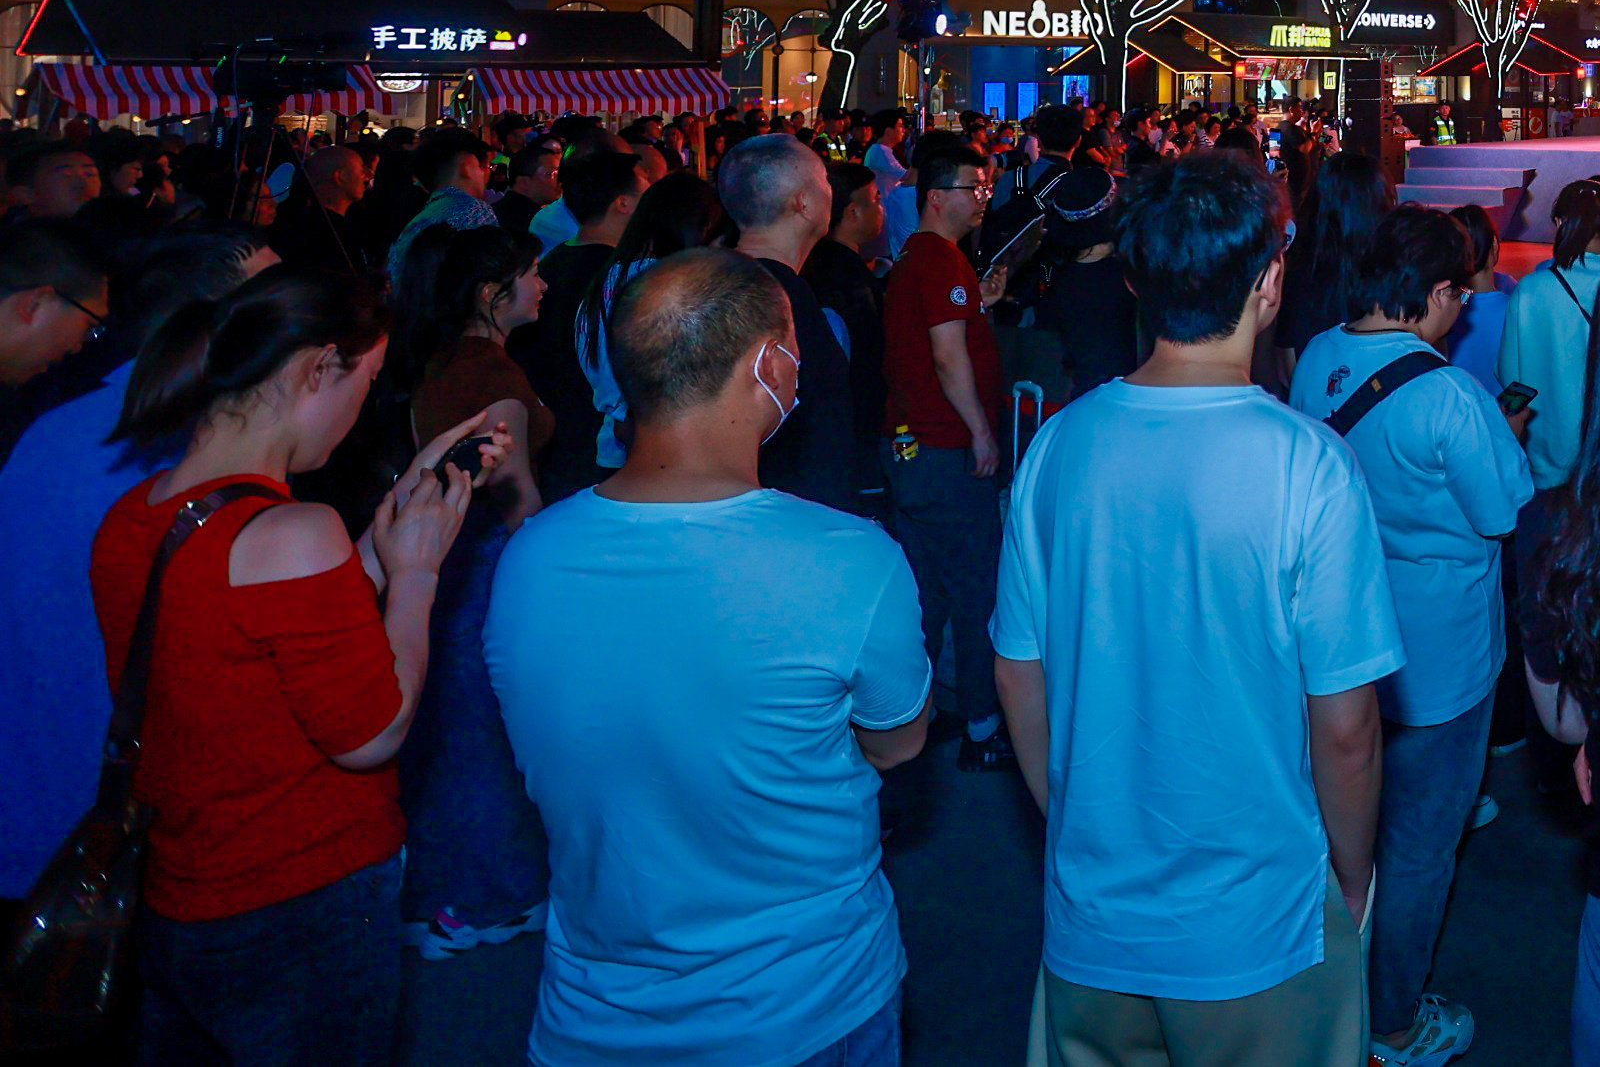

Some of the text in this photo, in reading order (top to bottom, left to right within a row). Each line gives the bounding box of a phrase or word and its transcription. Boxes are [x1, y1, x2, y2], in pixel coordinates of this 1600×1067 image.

[1356, 12, 1423, 29] ONVERSE
[371, 25, 488, 51] 手工披萨
